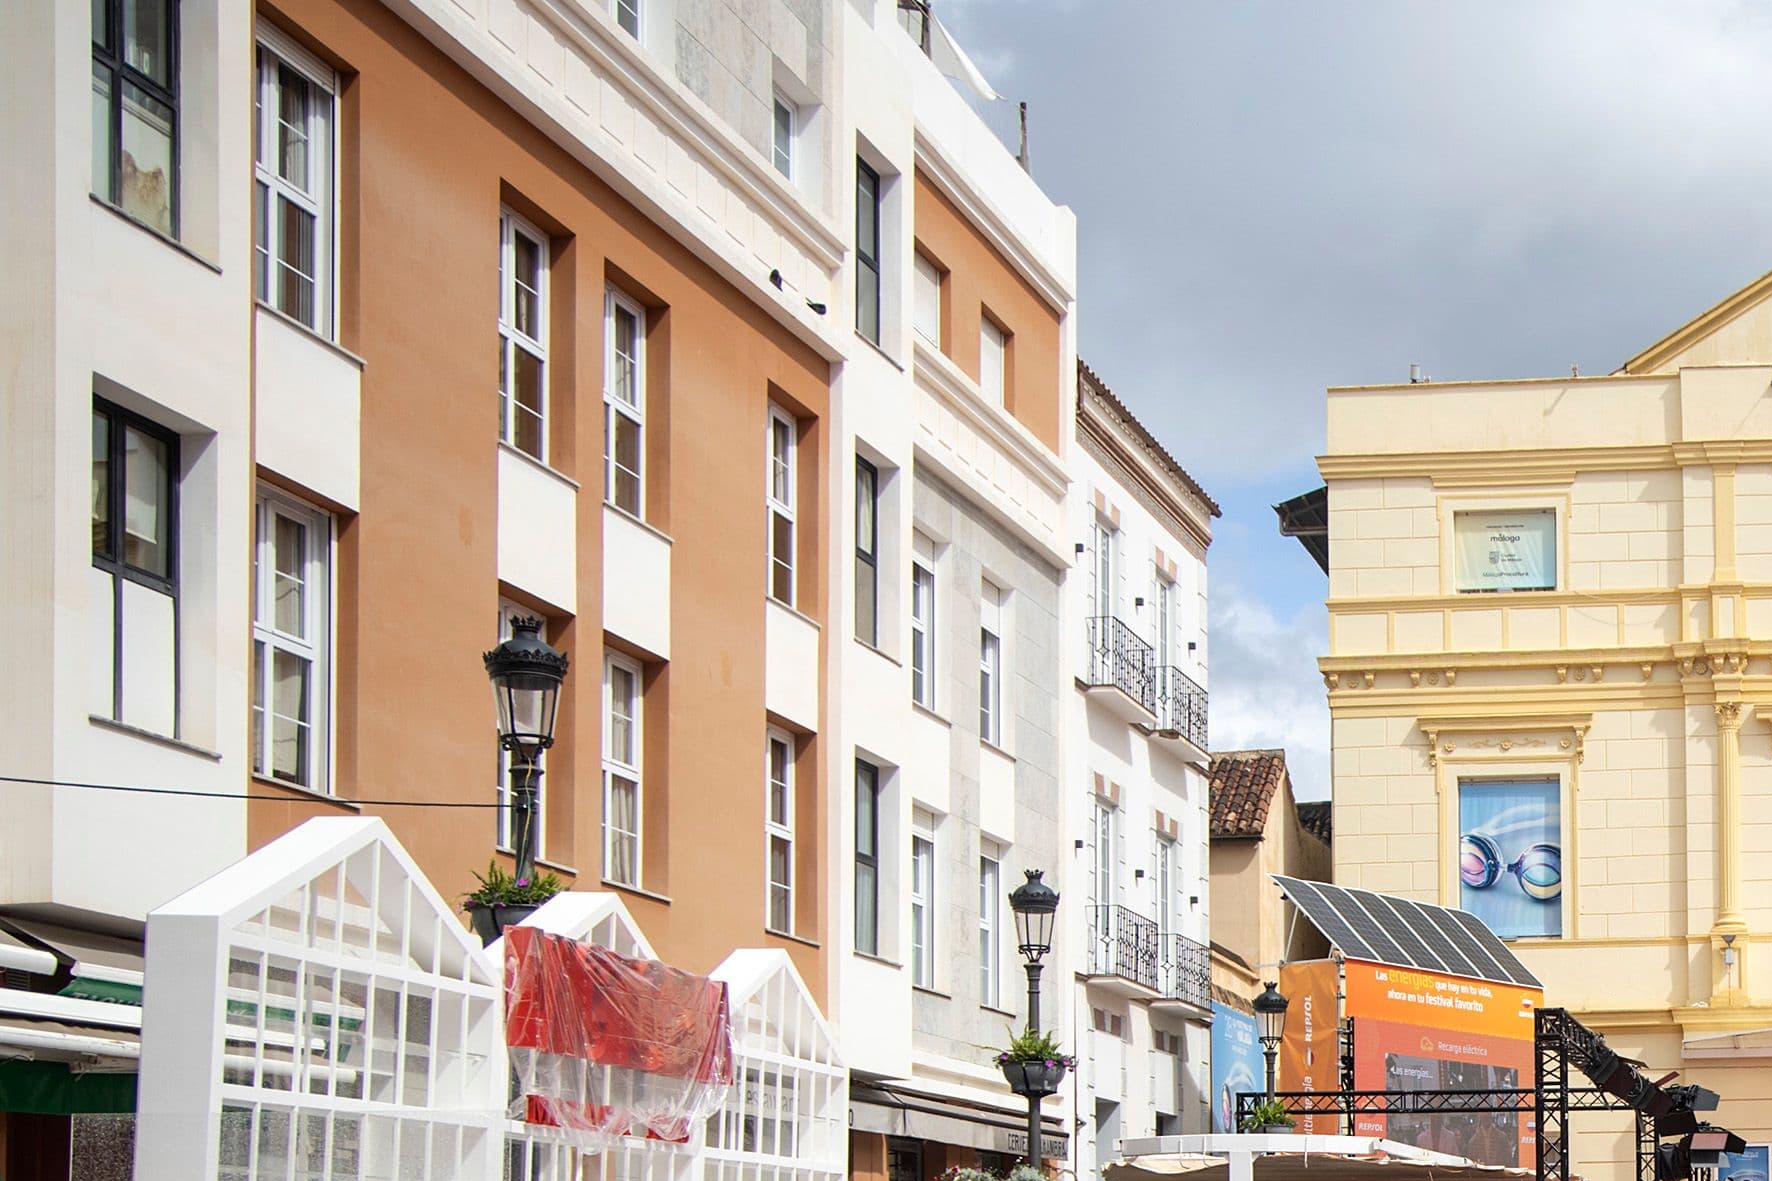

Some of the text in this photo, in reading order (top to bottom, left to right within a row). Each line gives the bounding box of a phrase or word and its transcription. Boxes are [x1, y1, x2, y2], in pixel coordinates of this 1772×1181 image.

[1388, 970, 1434, 989] energías
[1425, 992, 1453, 1008] festival
[1454, 997, 1484, 1012] favorito
[1304, 995, 1312, 1042] REPSOL
